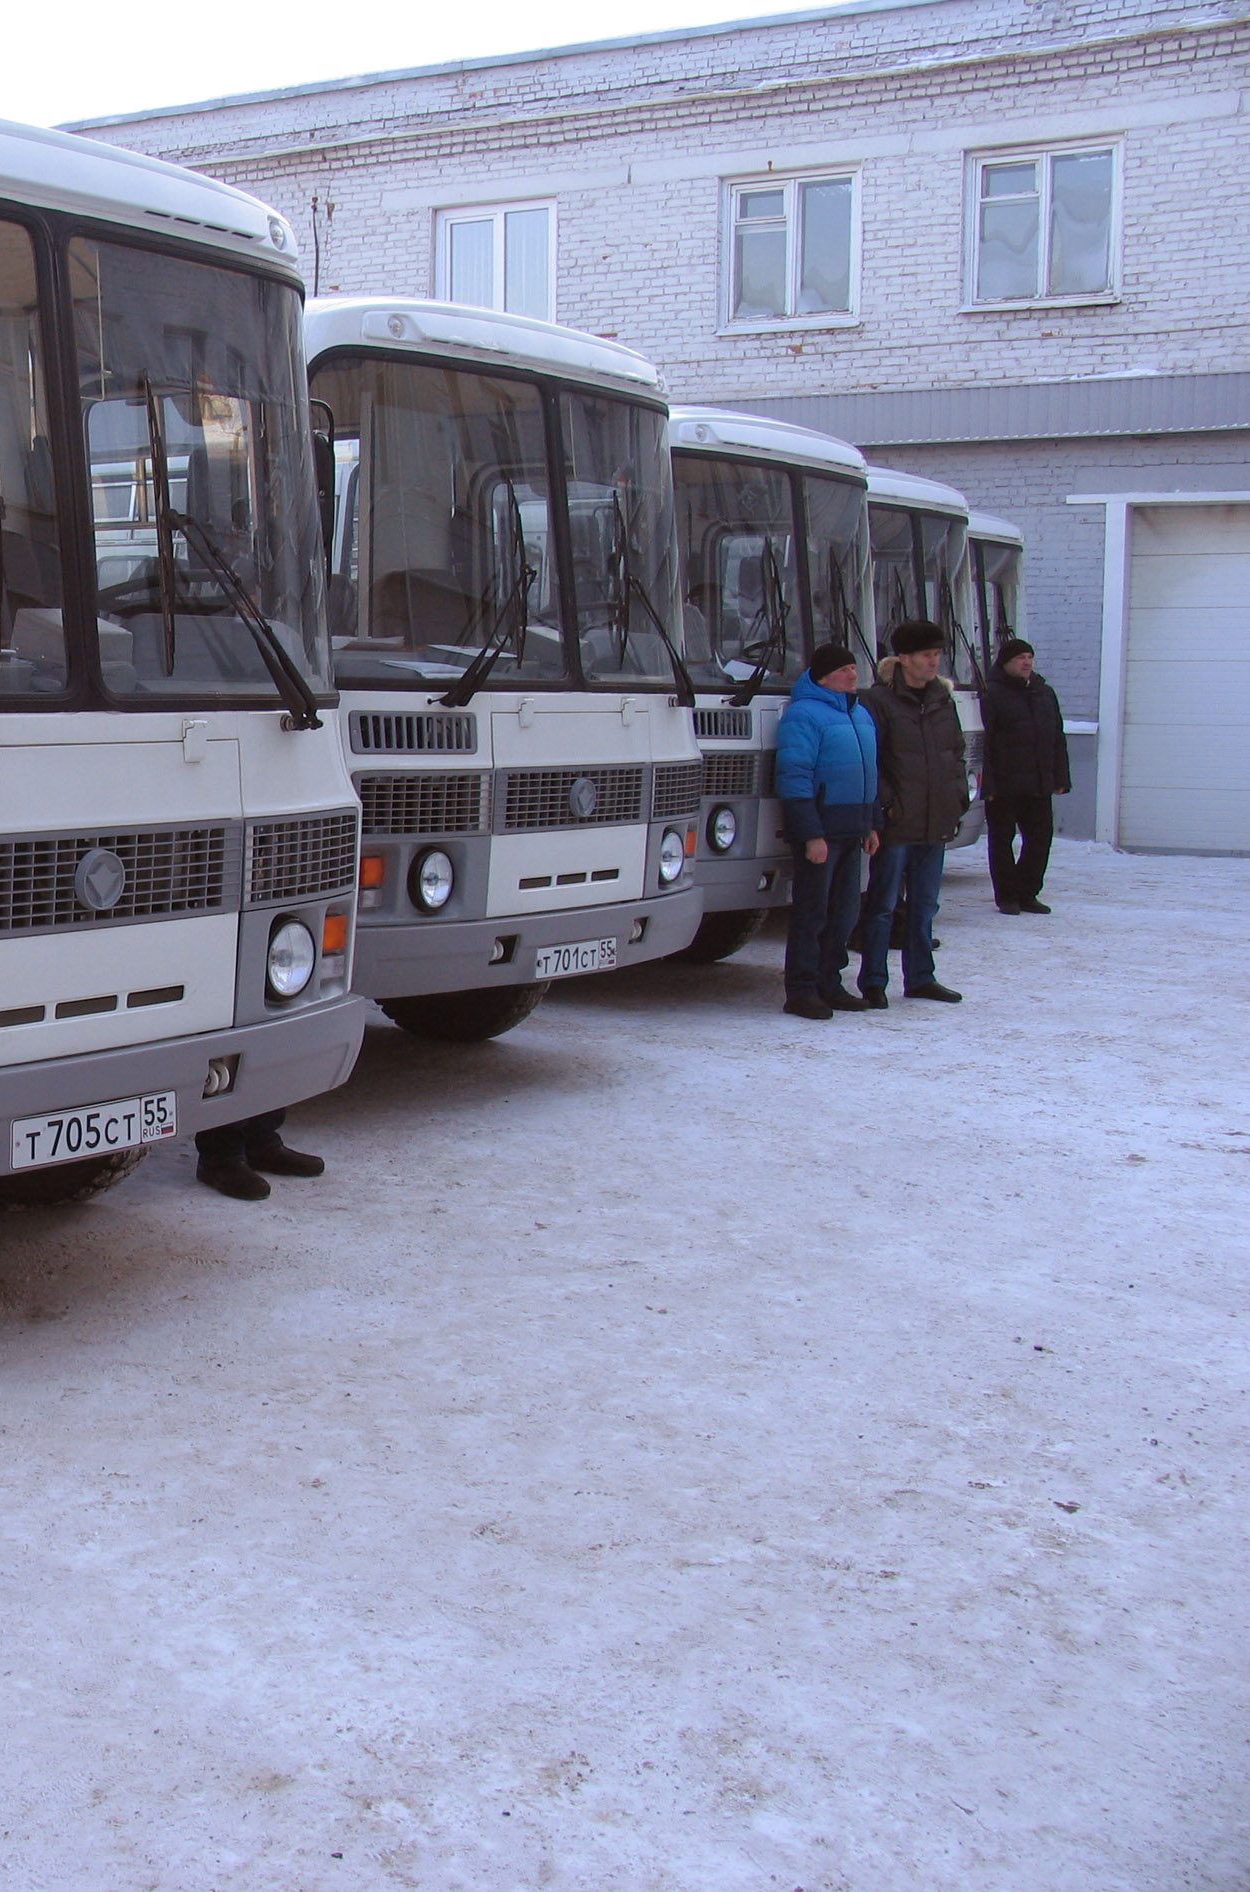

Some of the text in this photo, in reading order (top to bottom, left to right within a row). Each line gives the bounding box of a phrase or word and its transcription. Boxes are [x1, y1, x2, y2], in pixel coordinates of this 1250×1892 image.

[544, 941, 613, 973] Т701СТ 55
[26, 1097, 167, 1160] Т705СТ 55
[143, 1127, 161, 1138] RUS
